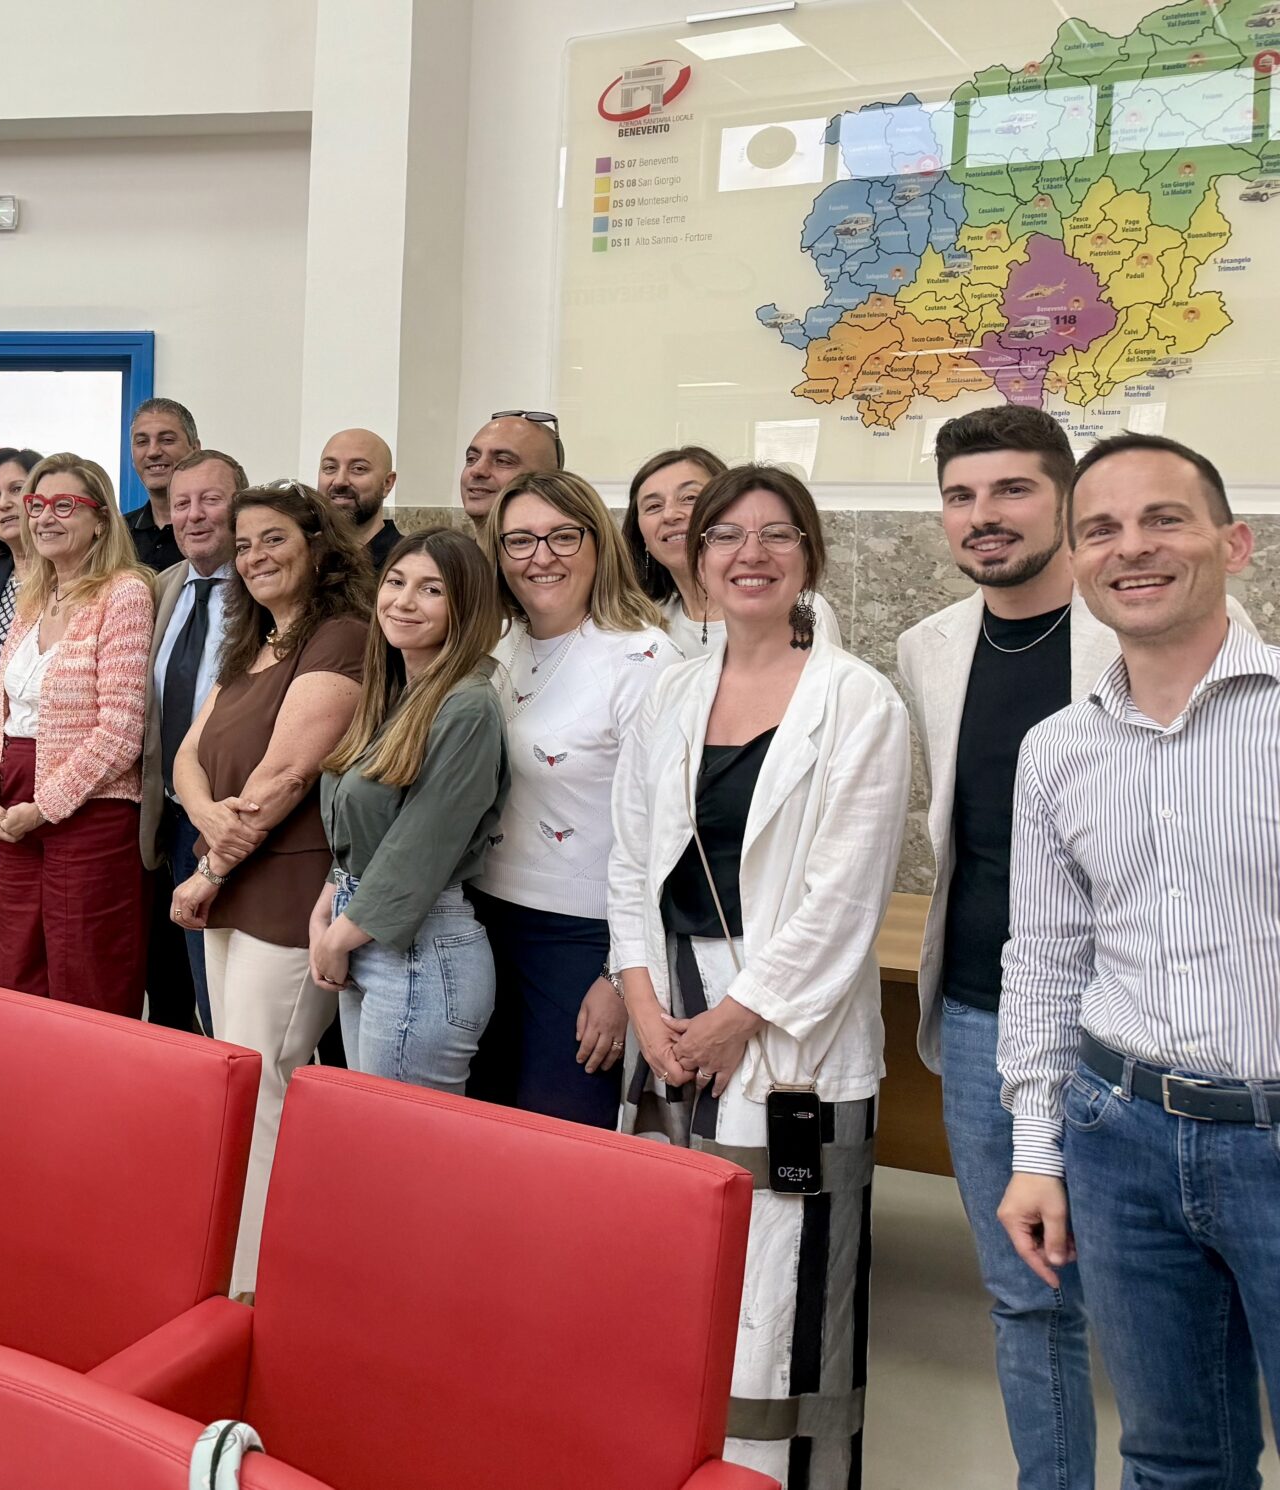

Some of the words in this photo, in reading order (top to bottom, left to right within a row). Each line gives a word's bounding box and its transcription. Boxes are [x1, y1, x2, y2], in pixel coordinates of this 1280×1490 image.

[673, 114, 694, 122] LOCALE
[618, 123, 670, 138] BENEVENTO
[614, 160, 625, 170] DS
[627, 159, 637, 168] 07
[639, 156, 679, 167] Benevento
[613, 179, 624, 189] DS
[626, 179, 637, 188] 08
[638, 178, 652, 187] San
[654, 176, 681, 186] Giorgio
[1172, 180, 1195, 188] Giorgio
[613, 199, 624, 209] DS
[625, 198, 636, 207] 09
[637, 194, 688, 206] Montesarchio
[612, 219, 623, 228] DS
[625, 218, 633, 227] 10
[636, 217, 660, 226] Telese
[662, 215, 686, 224] Terme
[611, 239, 622, 248] DS
[624, 238, 630, 247] 11
[635, 237, 650, 246] Alto
[651, 235, 678, 245] Sannio
[685, 232, 713, 242] Fortore
[1089, 249, 1121, 257] Pietrelcina
[971, 291, 999, 300] Foglianise
[1036, 305, 1067, 313] Benevento
[1054, 315, 1077, 325] 118
[777, 1166, 813, 1179] 14:20
